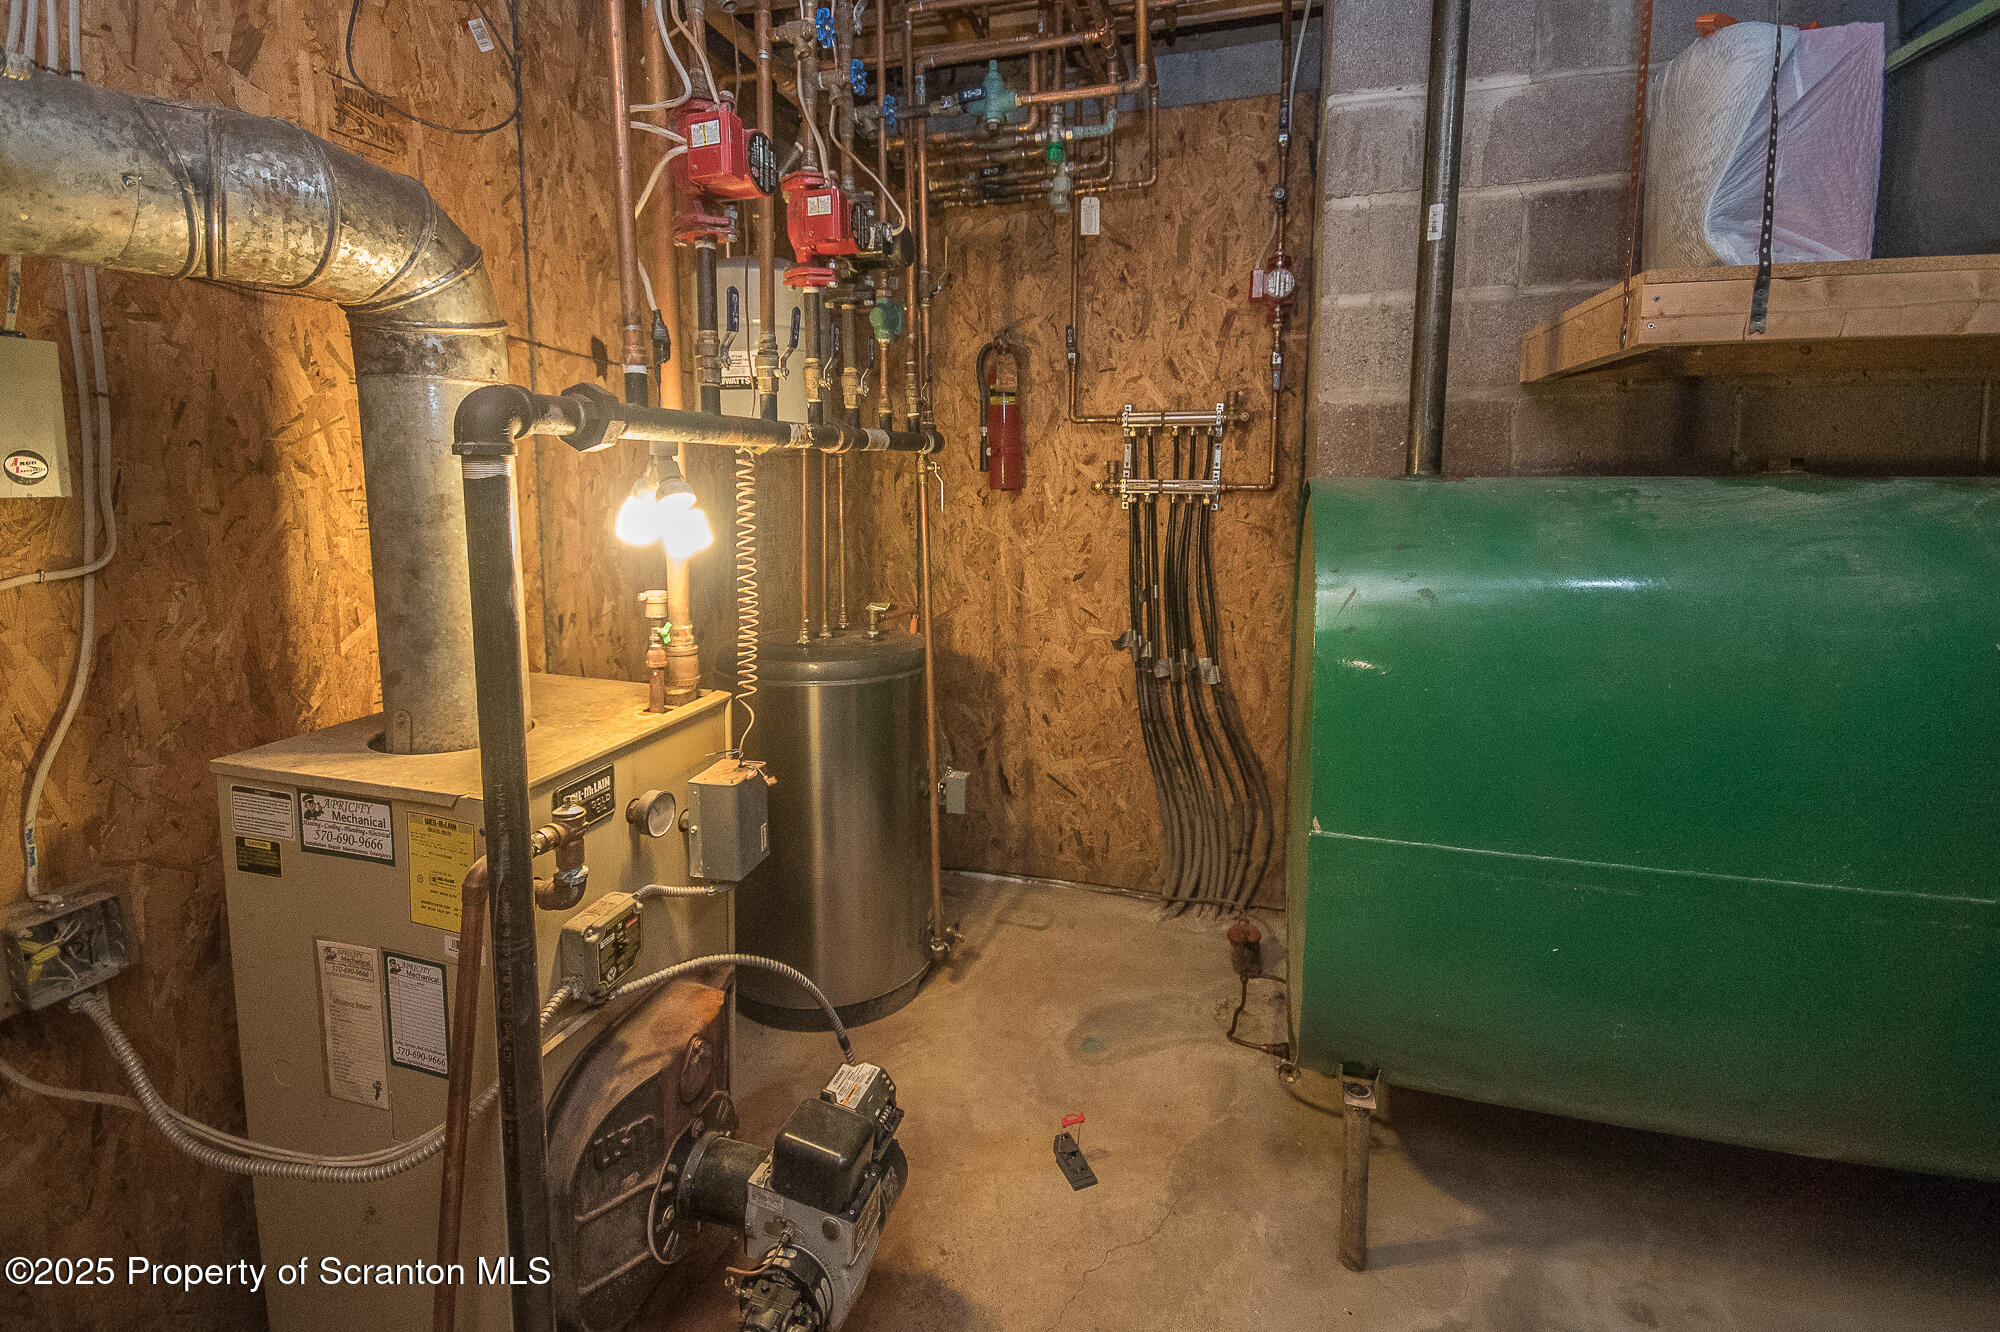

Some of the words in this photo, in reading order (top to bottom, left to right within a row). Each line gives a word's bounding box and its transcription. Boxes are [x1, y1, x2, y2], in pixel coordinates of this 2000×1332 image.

[722, 377, 751, 385] WATTS
[332, 811, 386, 829] Mechanical
[314, 829, 384, 851] 570-690-9666
[396, 1046, 446, 1066] 570-690-9666
